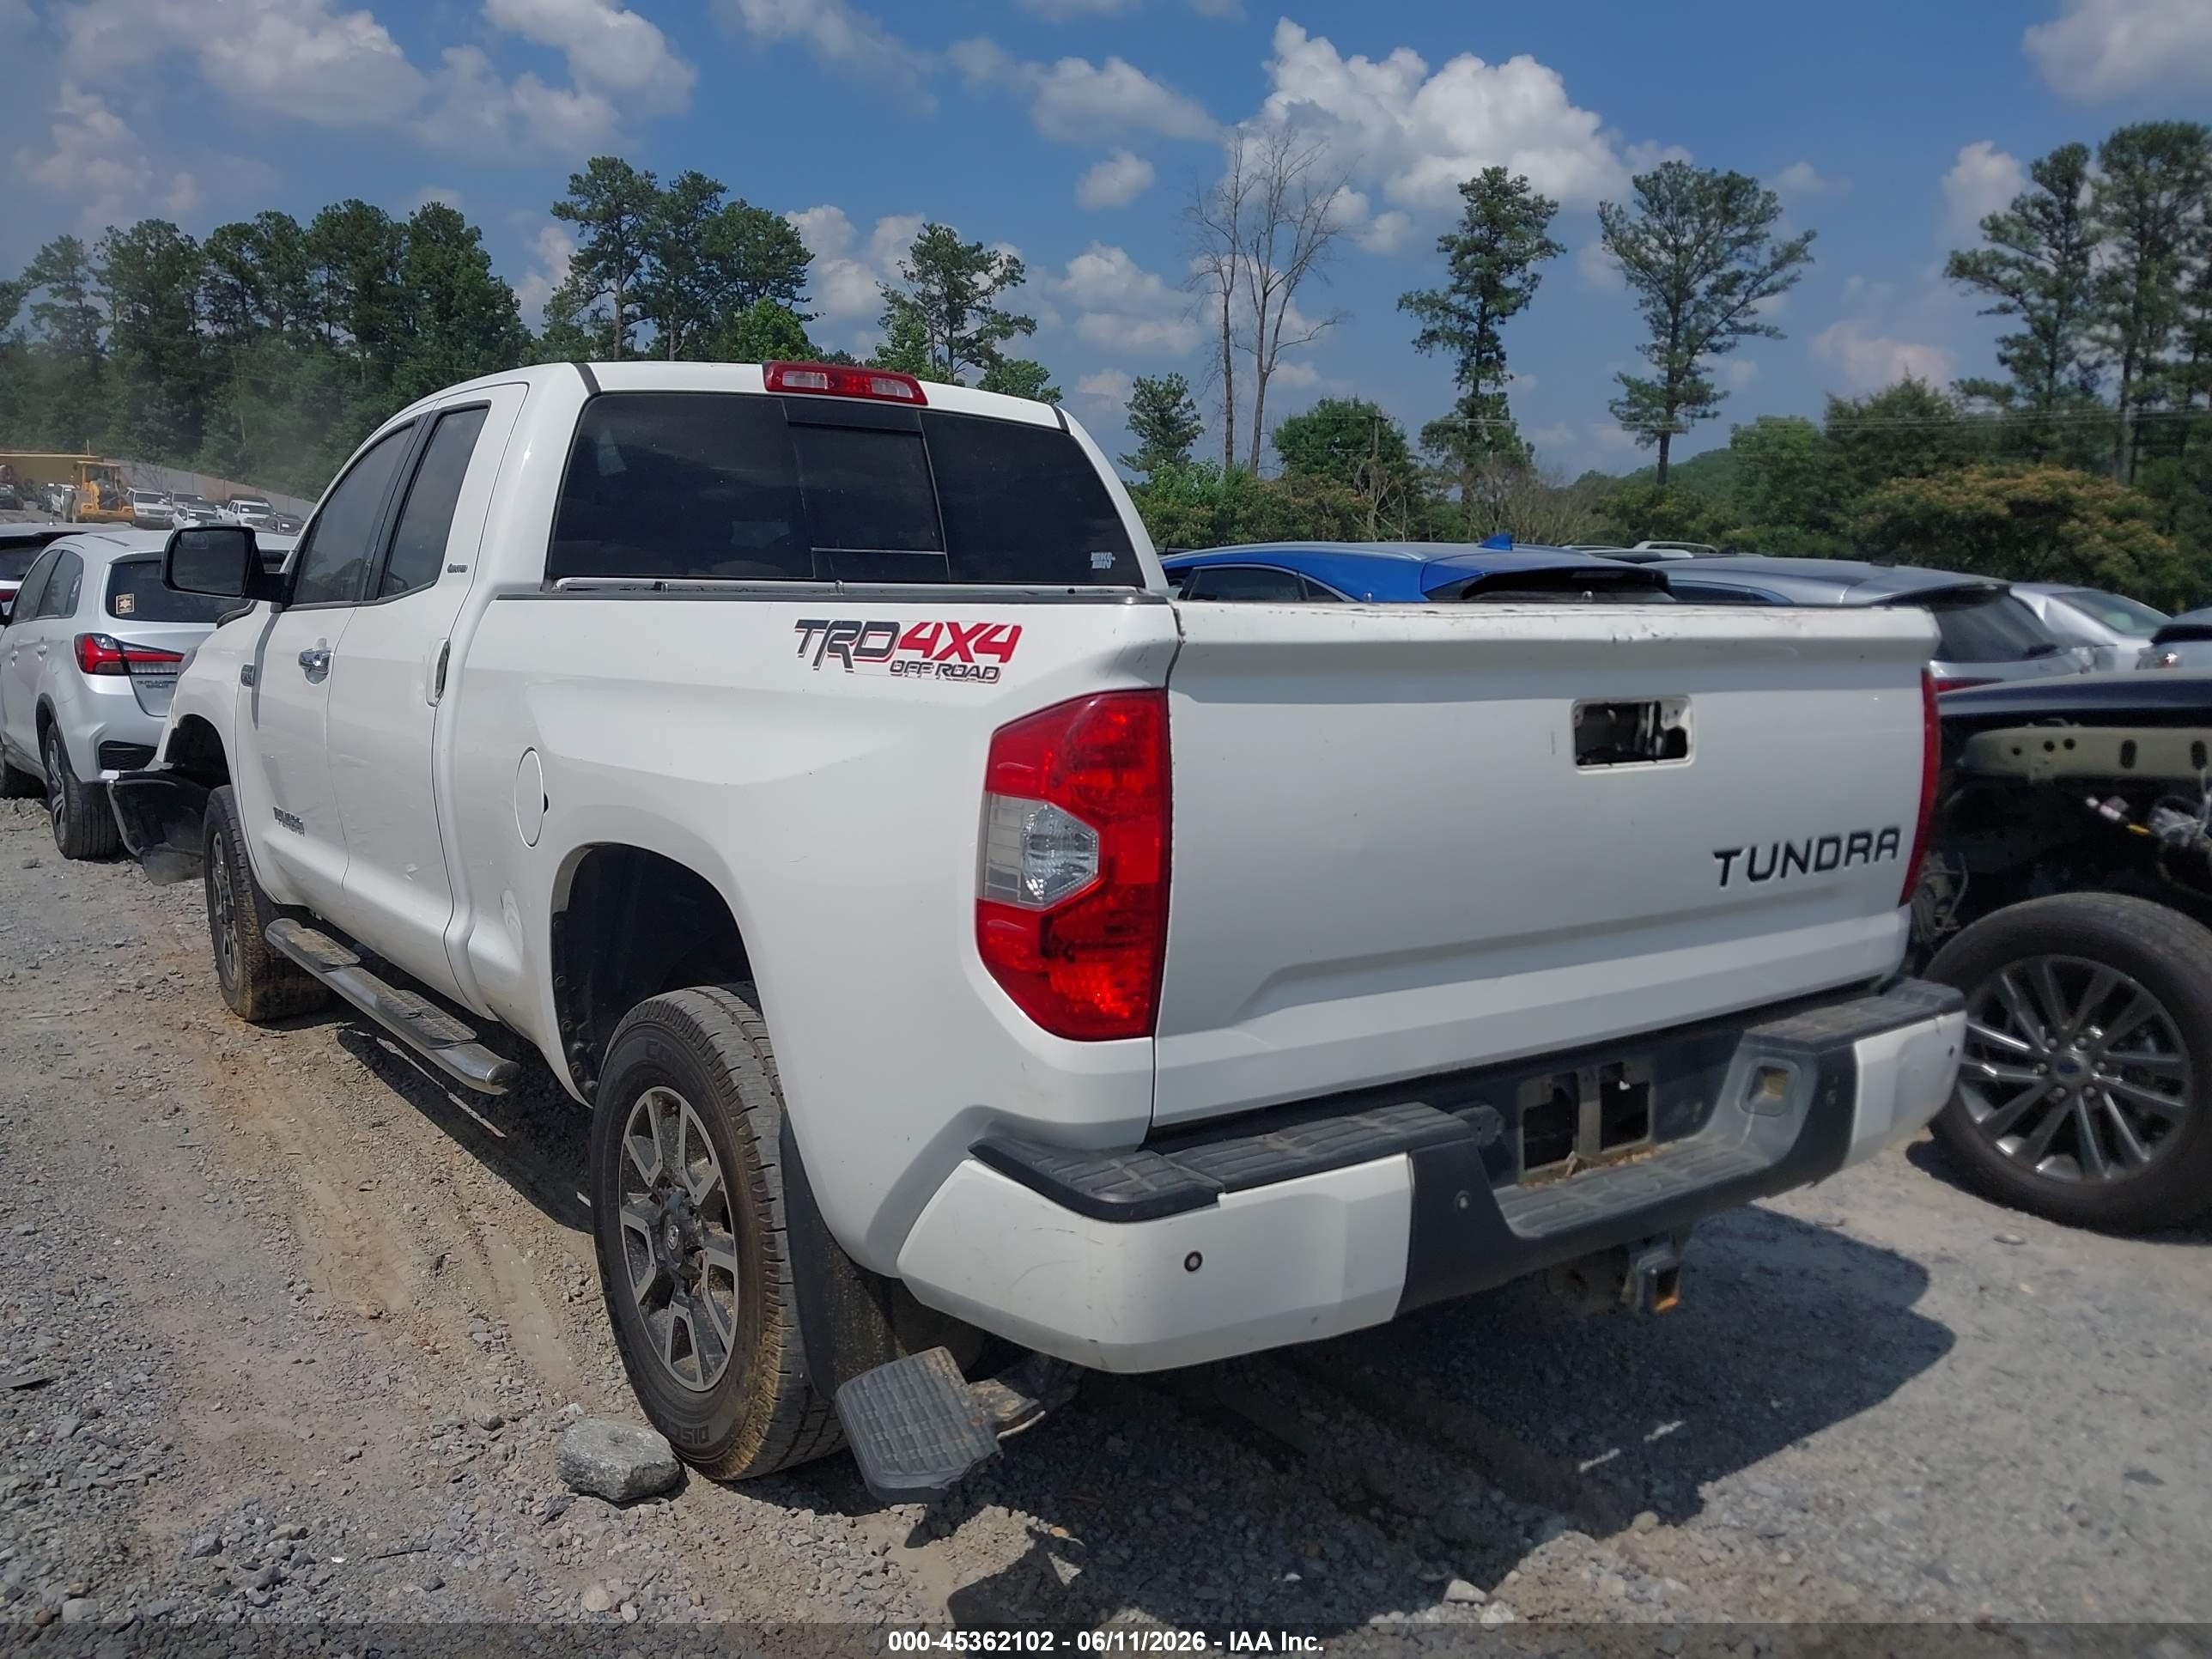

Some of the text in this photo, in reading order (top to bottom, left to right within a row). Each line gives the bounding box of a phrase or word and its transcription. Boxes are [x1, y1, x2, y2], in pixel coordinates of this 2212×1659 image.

[795, 619, 900, 672] TRD
[890, 660, 1001, 684] OFF ROAD
[1712, 825, 1900, 888] TUNDRA
